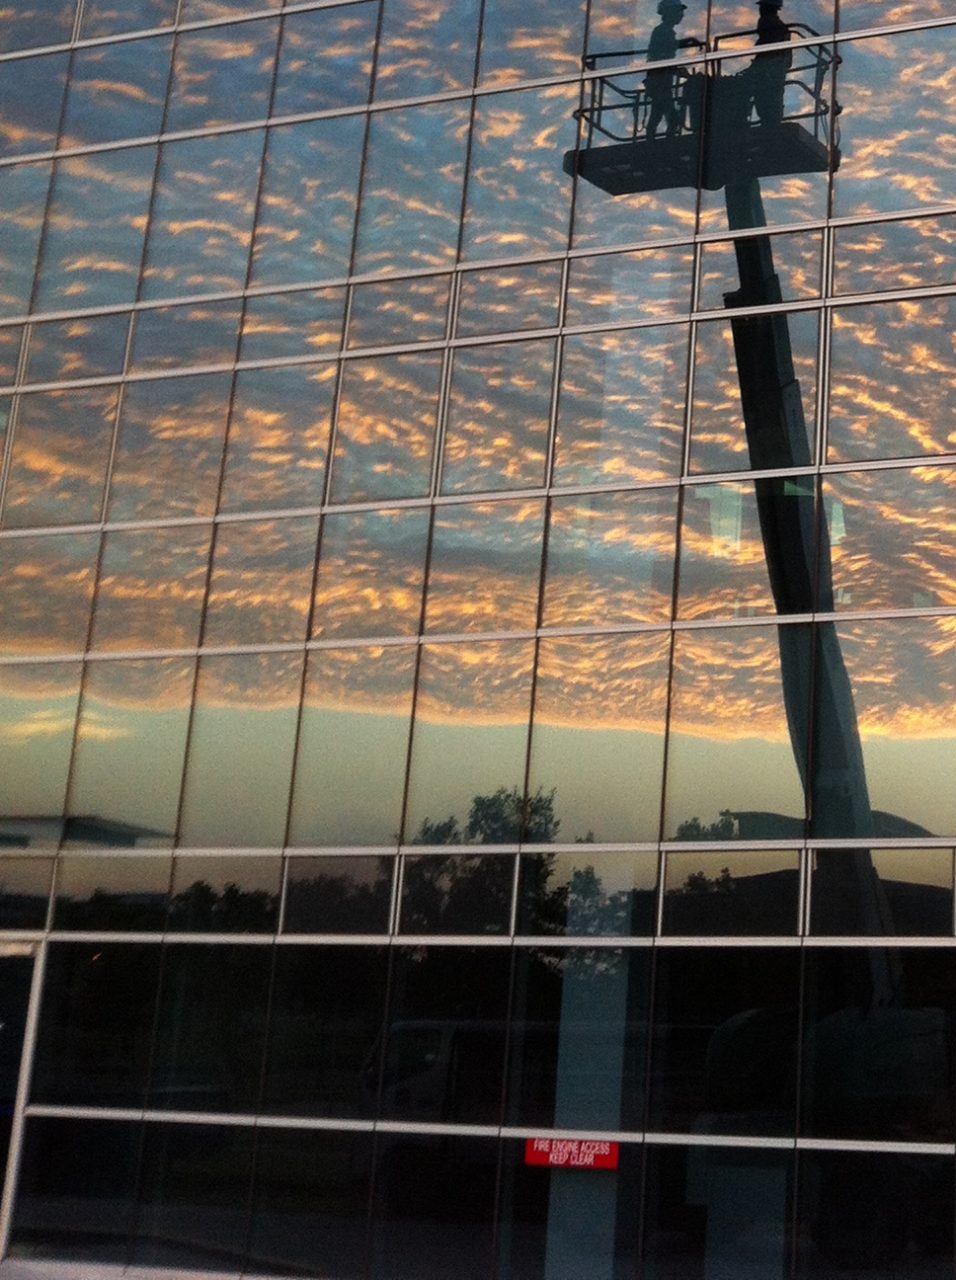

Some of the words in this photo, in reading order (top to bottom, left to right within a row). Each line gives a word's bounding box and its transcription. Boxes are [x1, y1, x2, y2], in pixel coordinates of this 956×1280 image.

[533, 1138, 550, 1152] FIRE
[551, 1139, 578, 1154] ENGINE
[580, 1141, 610, 1155] ACCESS
[548, 1152, 568, 1165] KEEP
[569, 1153, 594, 1166] CLEAR
